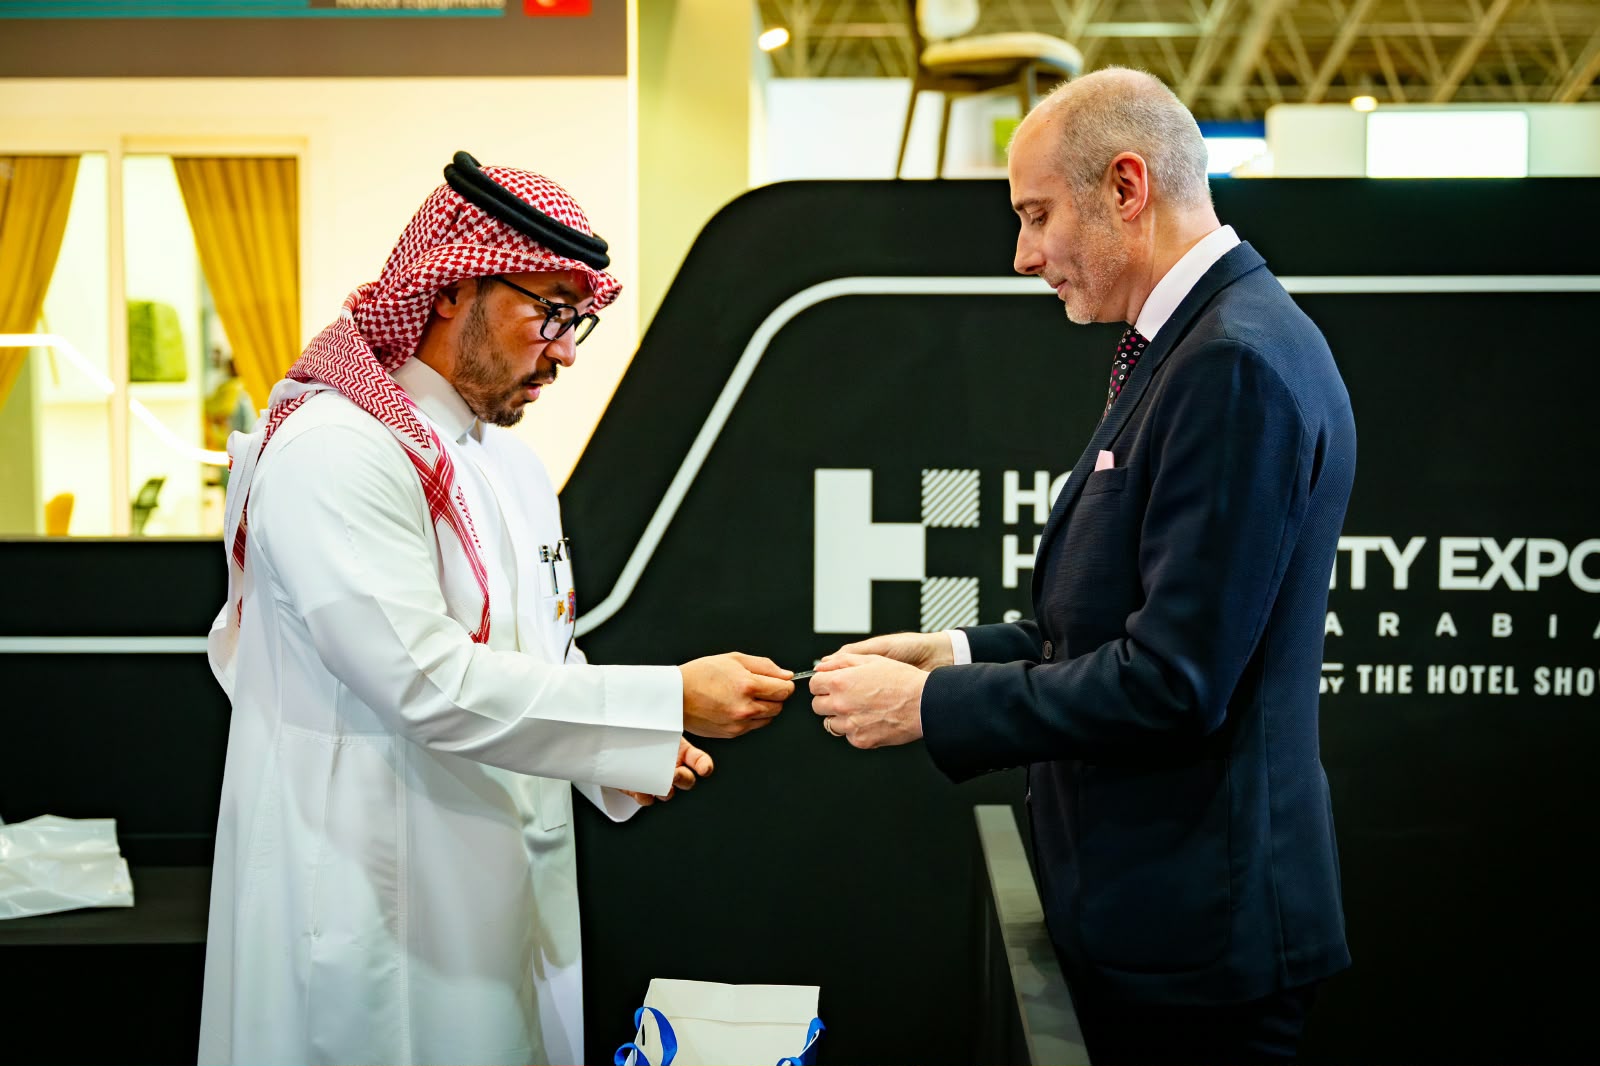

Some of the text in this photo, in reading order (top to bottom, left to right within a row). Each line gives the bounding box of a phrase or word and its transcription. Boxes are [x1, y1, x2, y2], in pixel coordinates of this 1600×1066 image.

[1323, 611, 1600, 639] ARABI
[1356, 664, 1413, 694] THE
[1427, 665, 1519, 695] HOTEL
[1534, 666, 1600, 696] SHO
